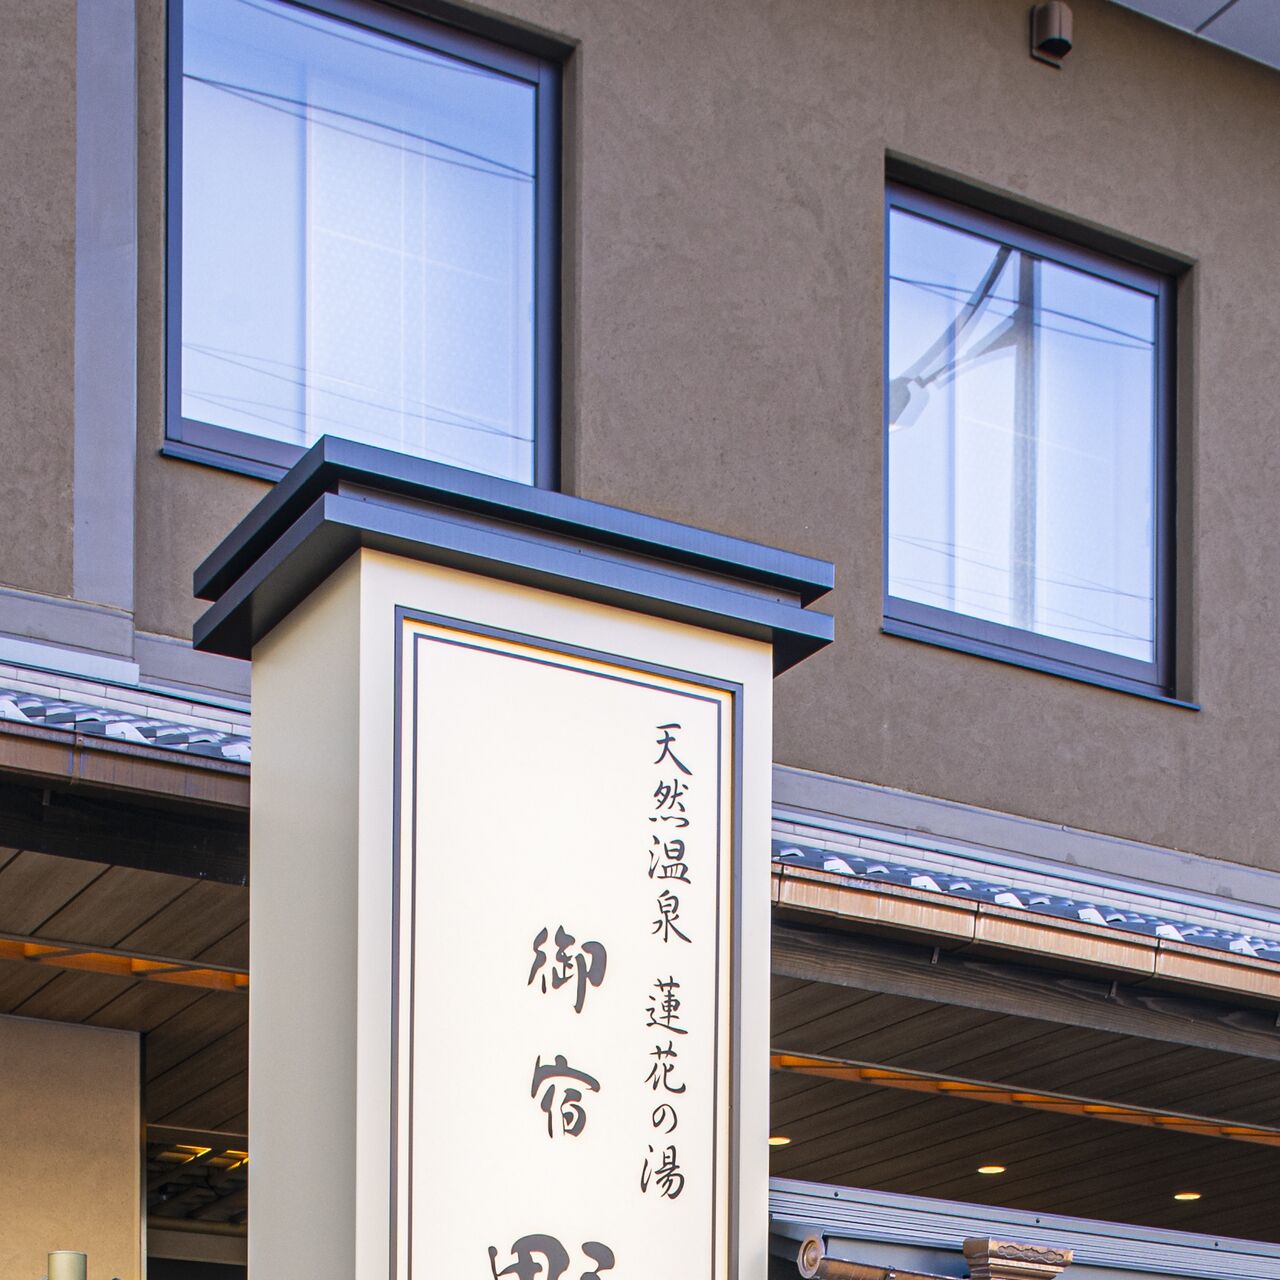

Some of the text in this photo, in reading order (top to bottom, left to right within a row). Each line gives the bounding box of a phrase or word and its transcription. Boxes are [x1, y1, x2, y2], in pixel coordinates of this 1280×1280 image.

[640, 723, 693, 1200] 天然温泉 蓮花の湯
